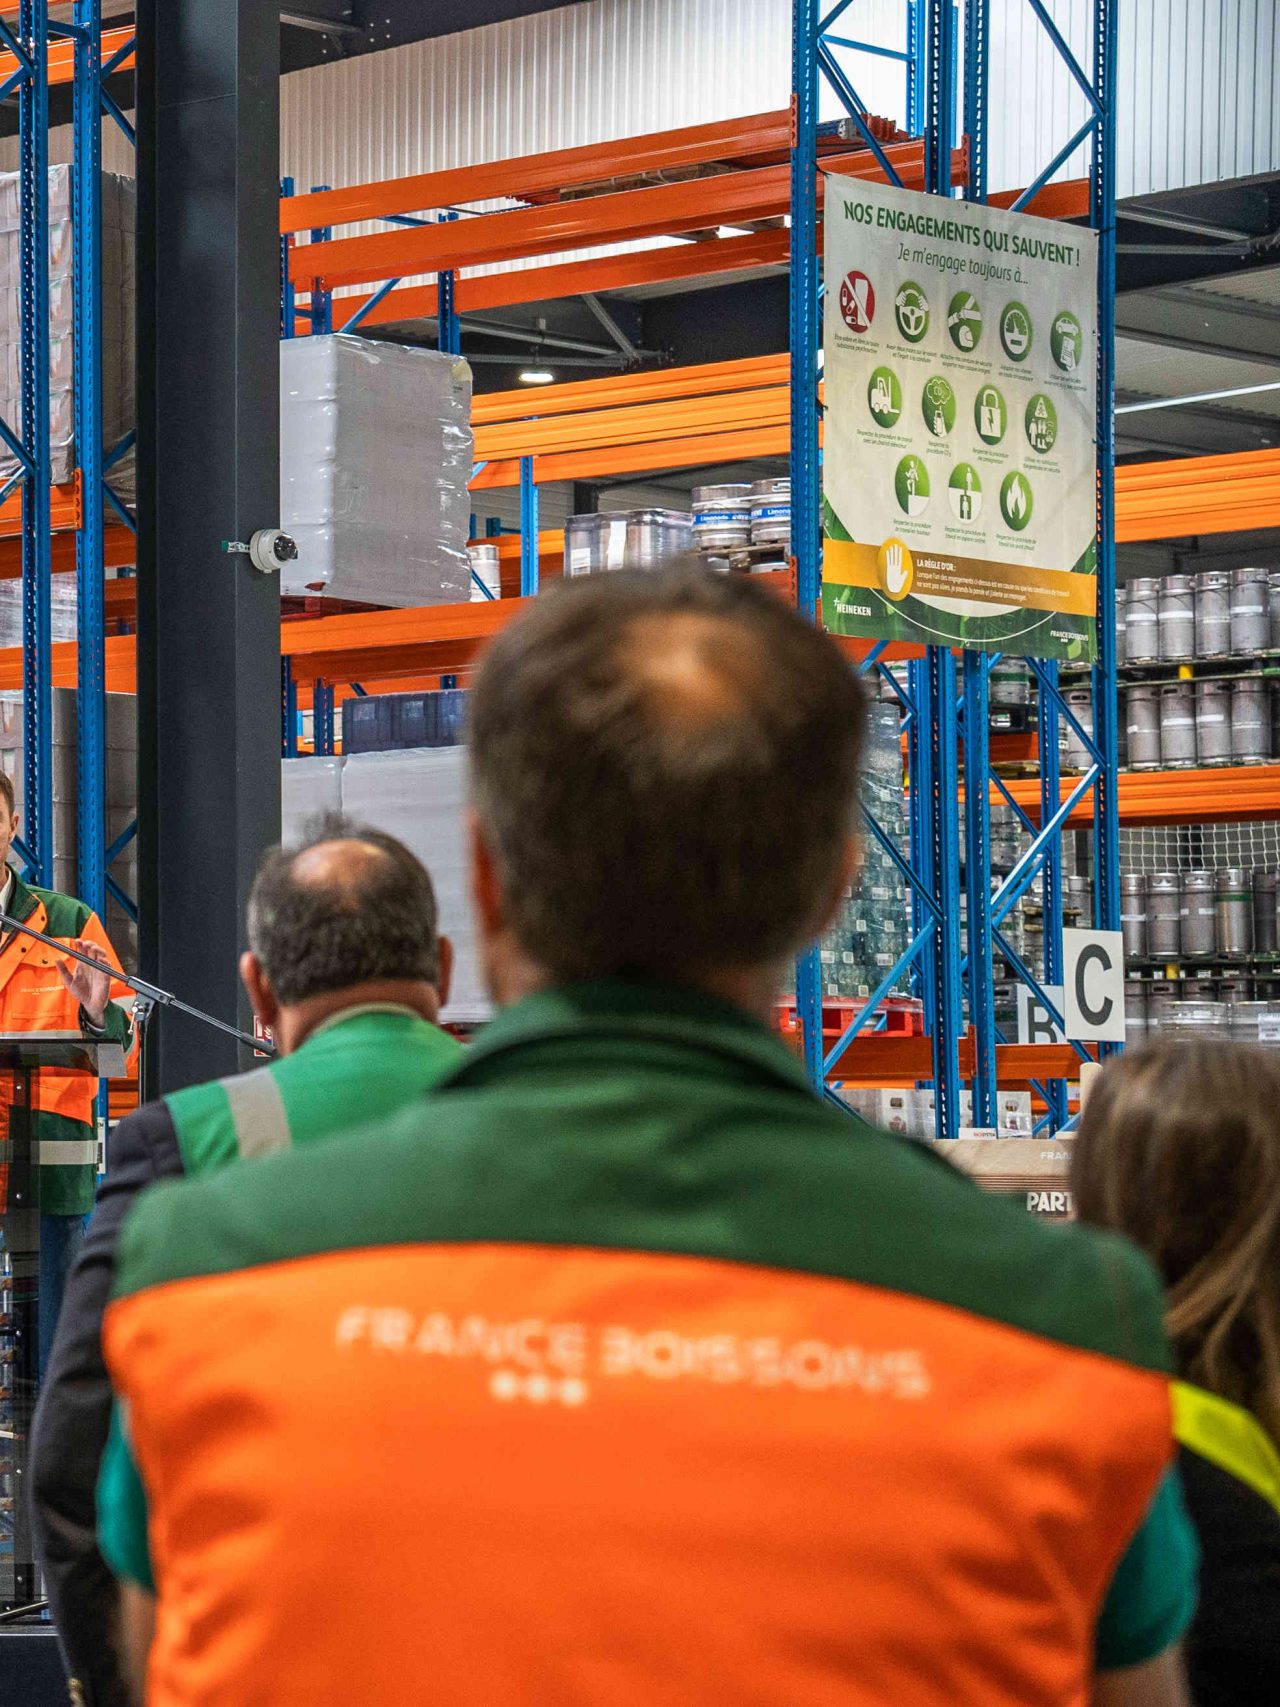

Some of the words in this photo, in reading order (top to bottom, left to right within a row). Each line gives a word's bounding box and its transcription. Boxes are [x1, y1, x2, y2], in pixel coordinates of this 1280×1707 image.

[843, 200, 873, 226] NOS
[876, 207, 980, 246] ENGAGEMENTS
[984, 231, 1009, 253] QUI
[1012, 237, 1074, 266] SAUVENT
[897, 242, 910, 261] Je
[912, 247, 967, 275] m'engage
[969, 259, 1012, 281] toujours
[916, 558, 924, 567] LA
[836, 603, 872, 616] HEINEKEN
[1075, 944, 1114, 1027] C
[1040, 1151, 1072, 1160] FRAN
[1026, 1191, 1073, 1212] PART
[336, 1306, 586, 1374] FRANCE
[601, 1326, 930, 1400] BOISSONS
